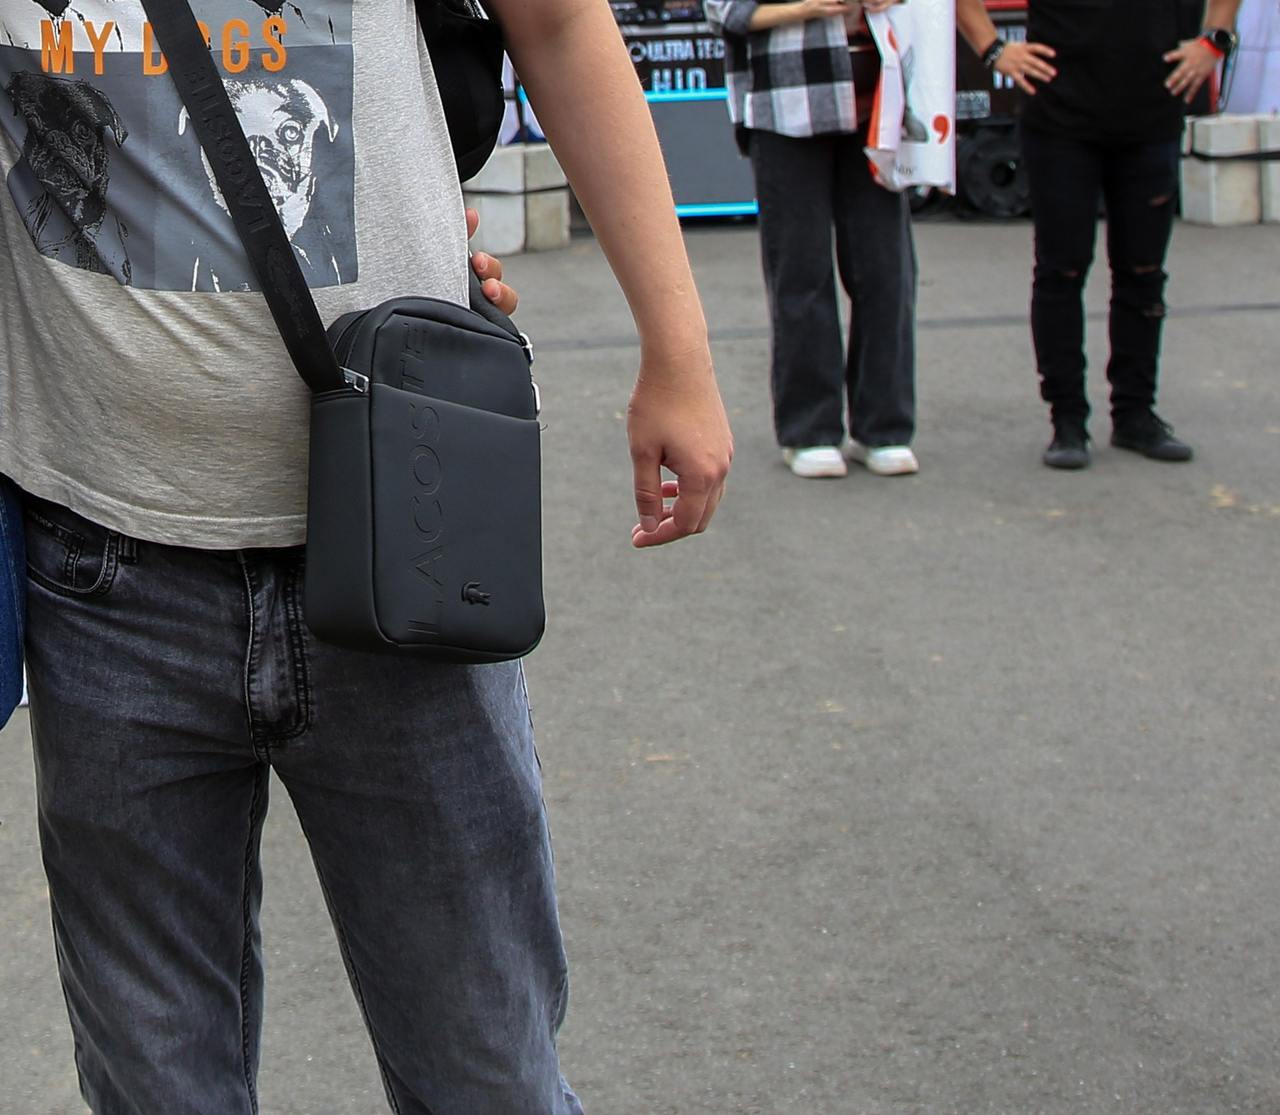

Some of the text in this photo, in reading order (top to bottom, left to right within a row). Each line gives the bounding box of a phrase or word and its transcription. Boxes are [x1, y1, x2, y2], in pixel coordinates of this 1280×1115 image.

[39, 16, 288, 76] MY DGS
[646, 39, 695, 62] ULTRA
[183, 63, 272, 234] LACOSTE
